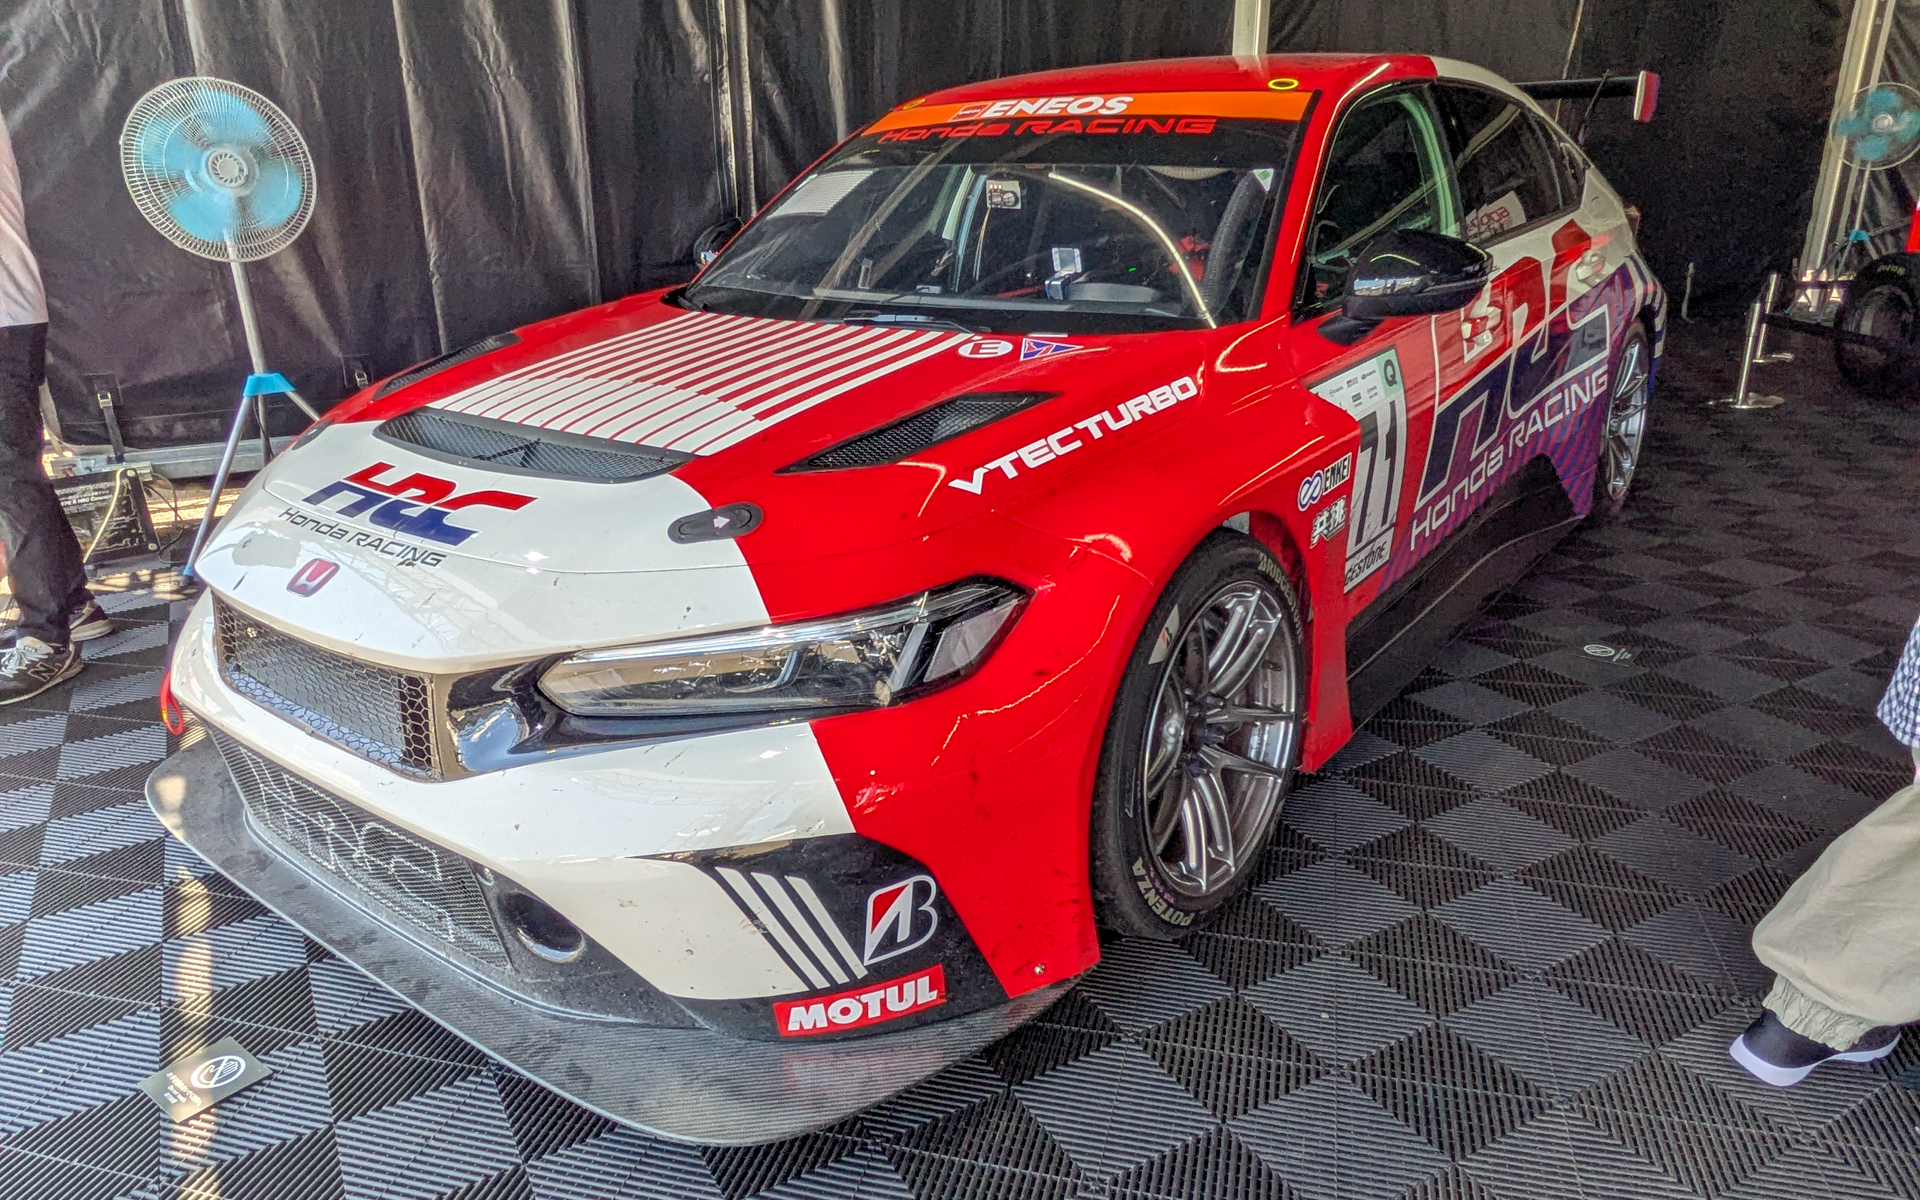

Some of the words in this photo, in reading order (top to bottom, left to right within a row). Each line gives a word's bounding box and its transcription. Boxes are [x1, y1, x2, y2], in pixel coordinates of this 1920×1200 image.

[877, 122, 1012, 144] Honda
[1014, 117, 1218, 136] RACING
[981, 96, 1134, 118] ENEOS
[1383, 358, 1398, 387] Q
[948, 426, 1083, 495] VTEC
[1073, 376, 1198, 440] TURBO
[1410, 443, 1504, 551] Honda
[1507, 364, 1609, 458] RACING
[1324, 455, 1351, 492] ENKEI
[1355, 399, 1398, 547] 71
[302, 461, 540, 546] HRC
[1310, 495, 1347, 549] 共挑
[278, 507, 350, 541] Honda
[347, 531, 448, 568] RACING
[1132, 856, 1196, 926] POTENZA
[787, 975, 938, 1031] MOTUL
